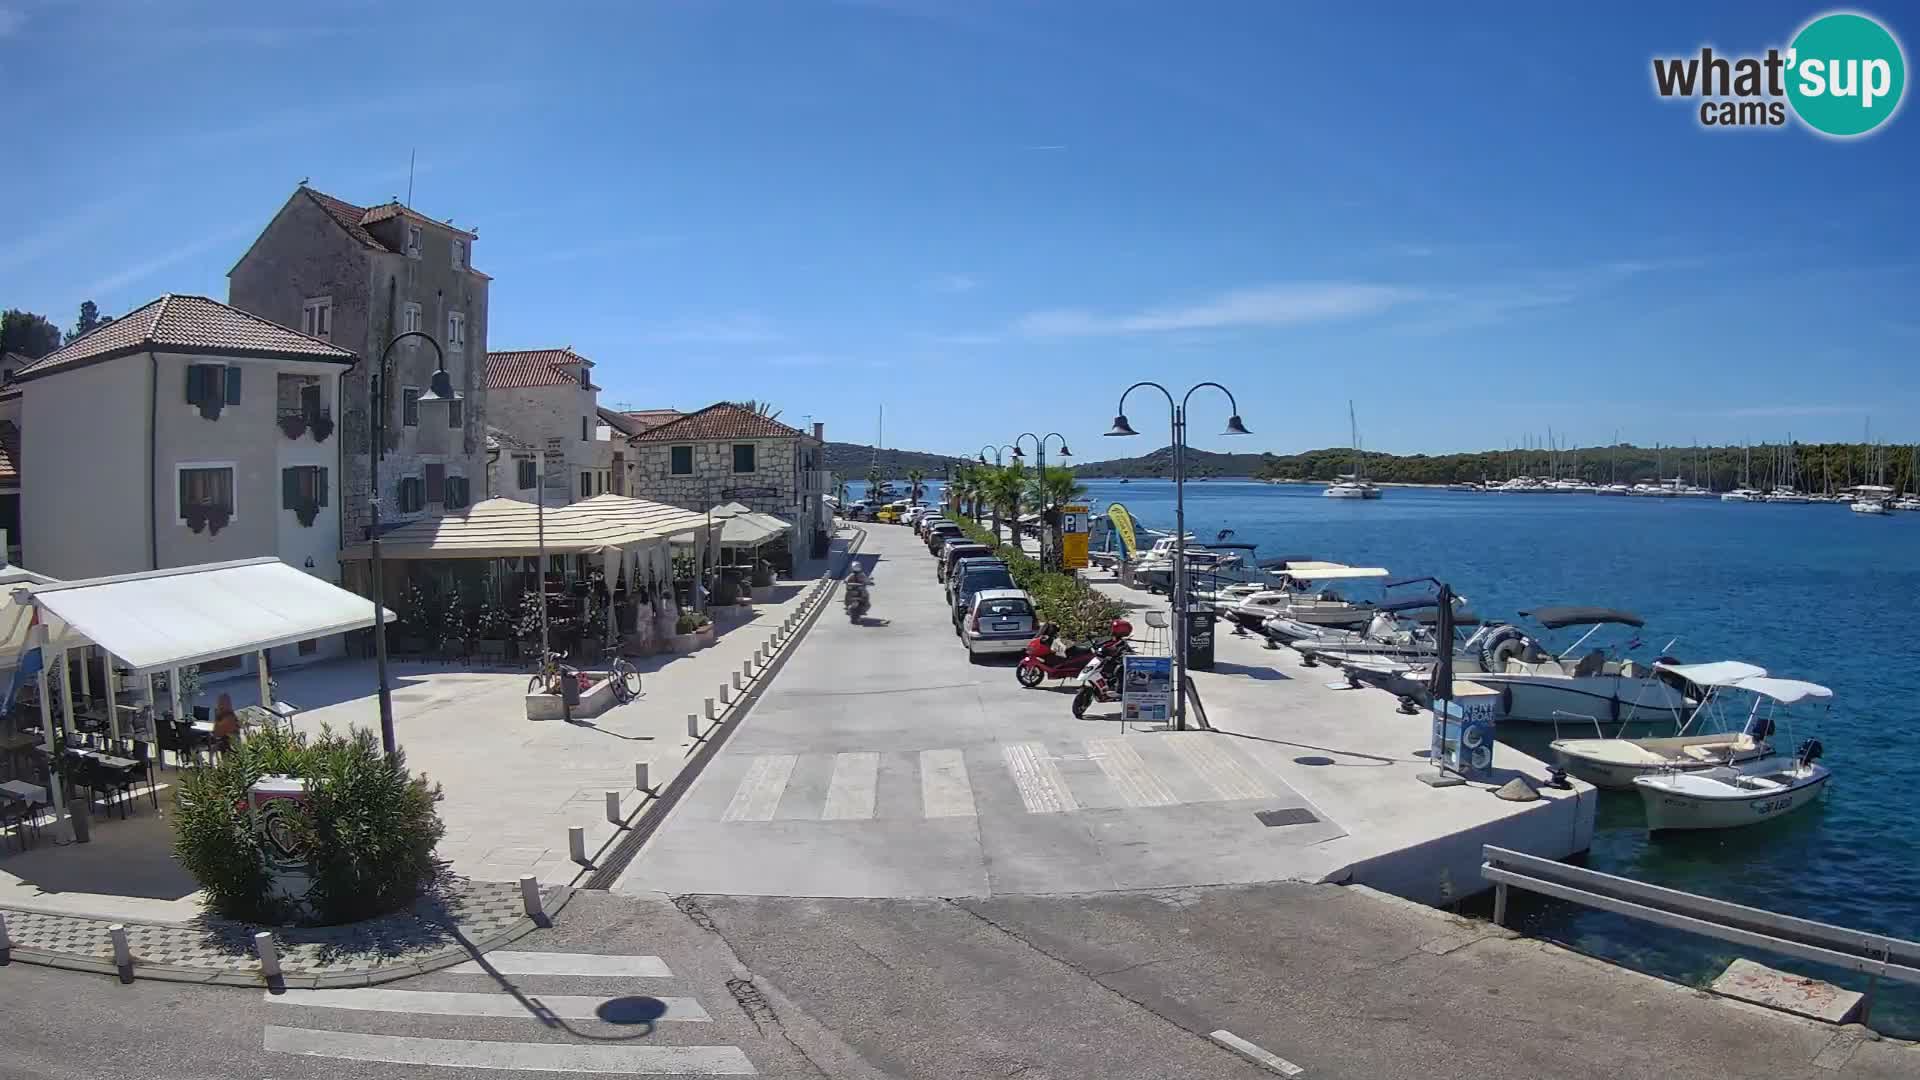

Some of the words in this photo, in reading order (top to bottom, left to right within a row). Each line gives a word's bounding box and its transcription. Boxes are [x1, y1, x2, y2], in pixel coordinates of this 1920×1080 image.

[1064, 514, 1076, 532] P
[1463, 703, 1495, 713] RENT
[1462, 712, 1470, 722] A
[1471, 712, 1495, 721] BOAT
